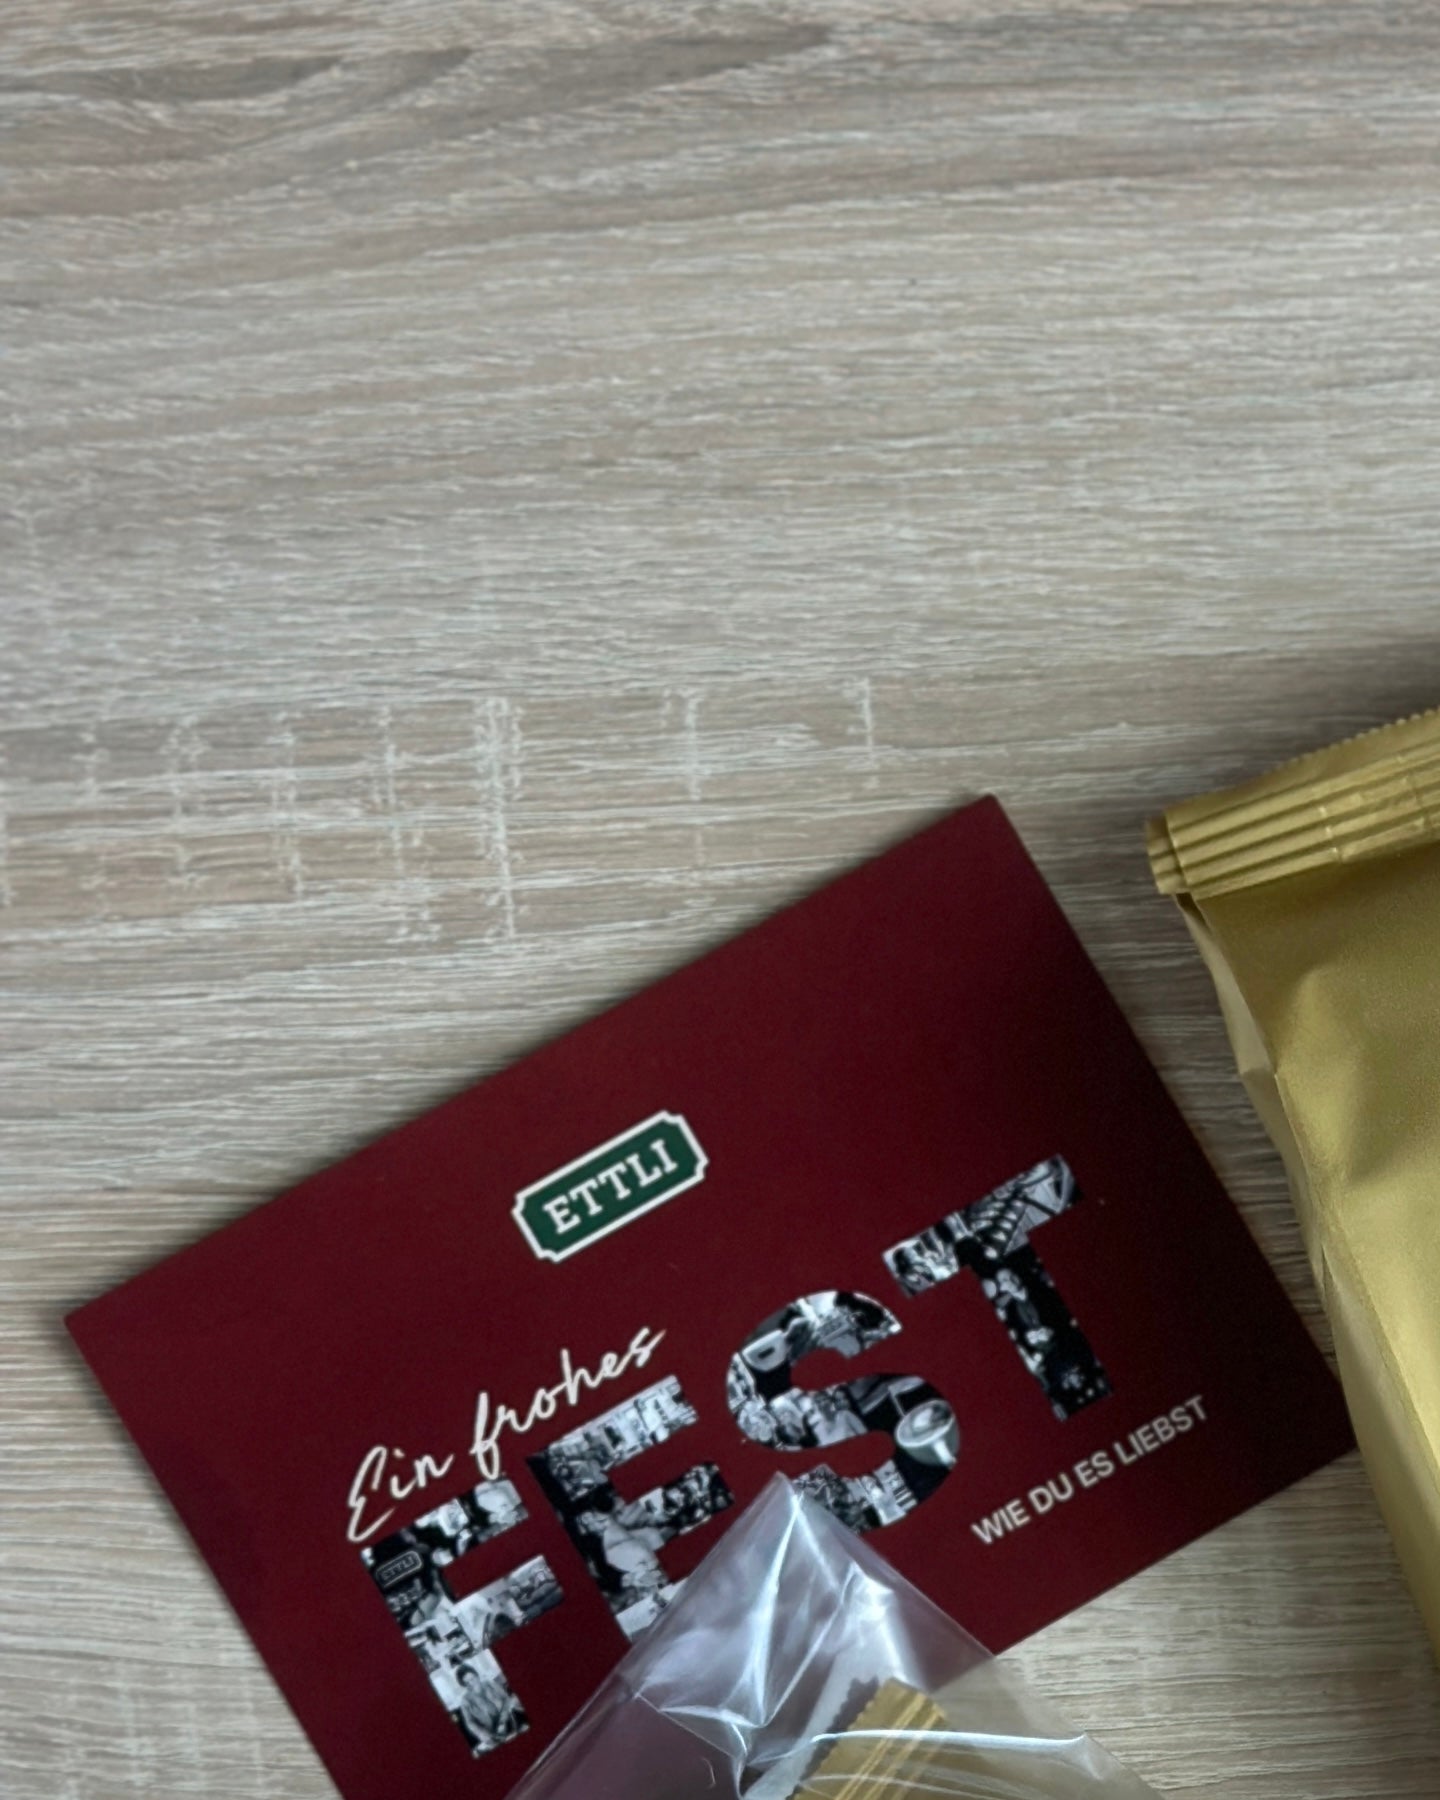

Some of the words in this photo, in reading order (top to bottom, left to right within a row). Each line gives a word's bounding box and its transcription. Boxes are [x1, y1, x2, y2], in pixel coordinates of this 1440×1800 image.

[542, 1138, 678, 1234] ETTLI
[347, 1446, 454, 1543] Ein
[469, 1326, 667, 1481] frohes
[360, 1153, 1112, 1758] FEST
[971, 1499, 1031, 1545] WIE
[1027, 1473, 1075, 1515] DU
[1073, 1449, 1116, 1488] ES
[1113, 1394, 1208, 1466] LIEBST
